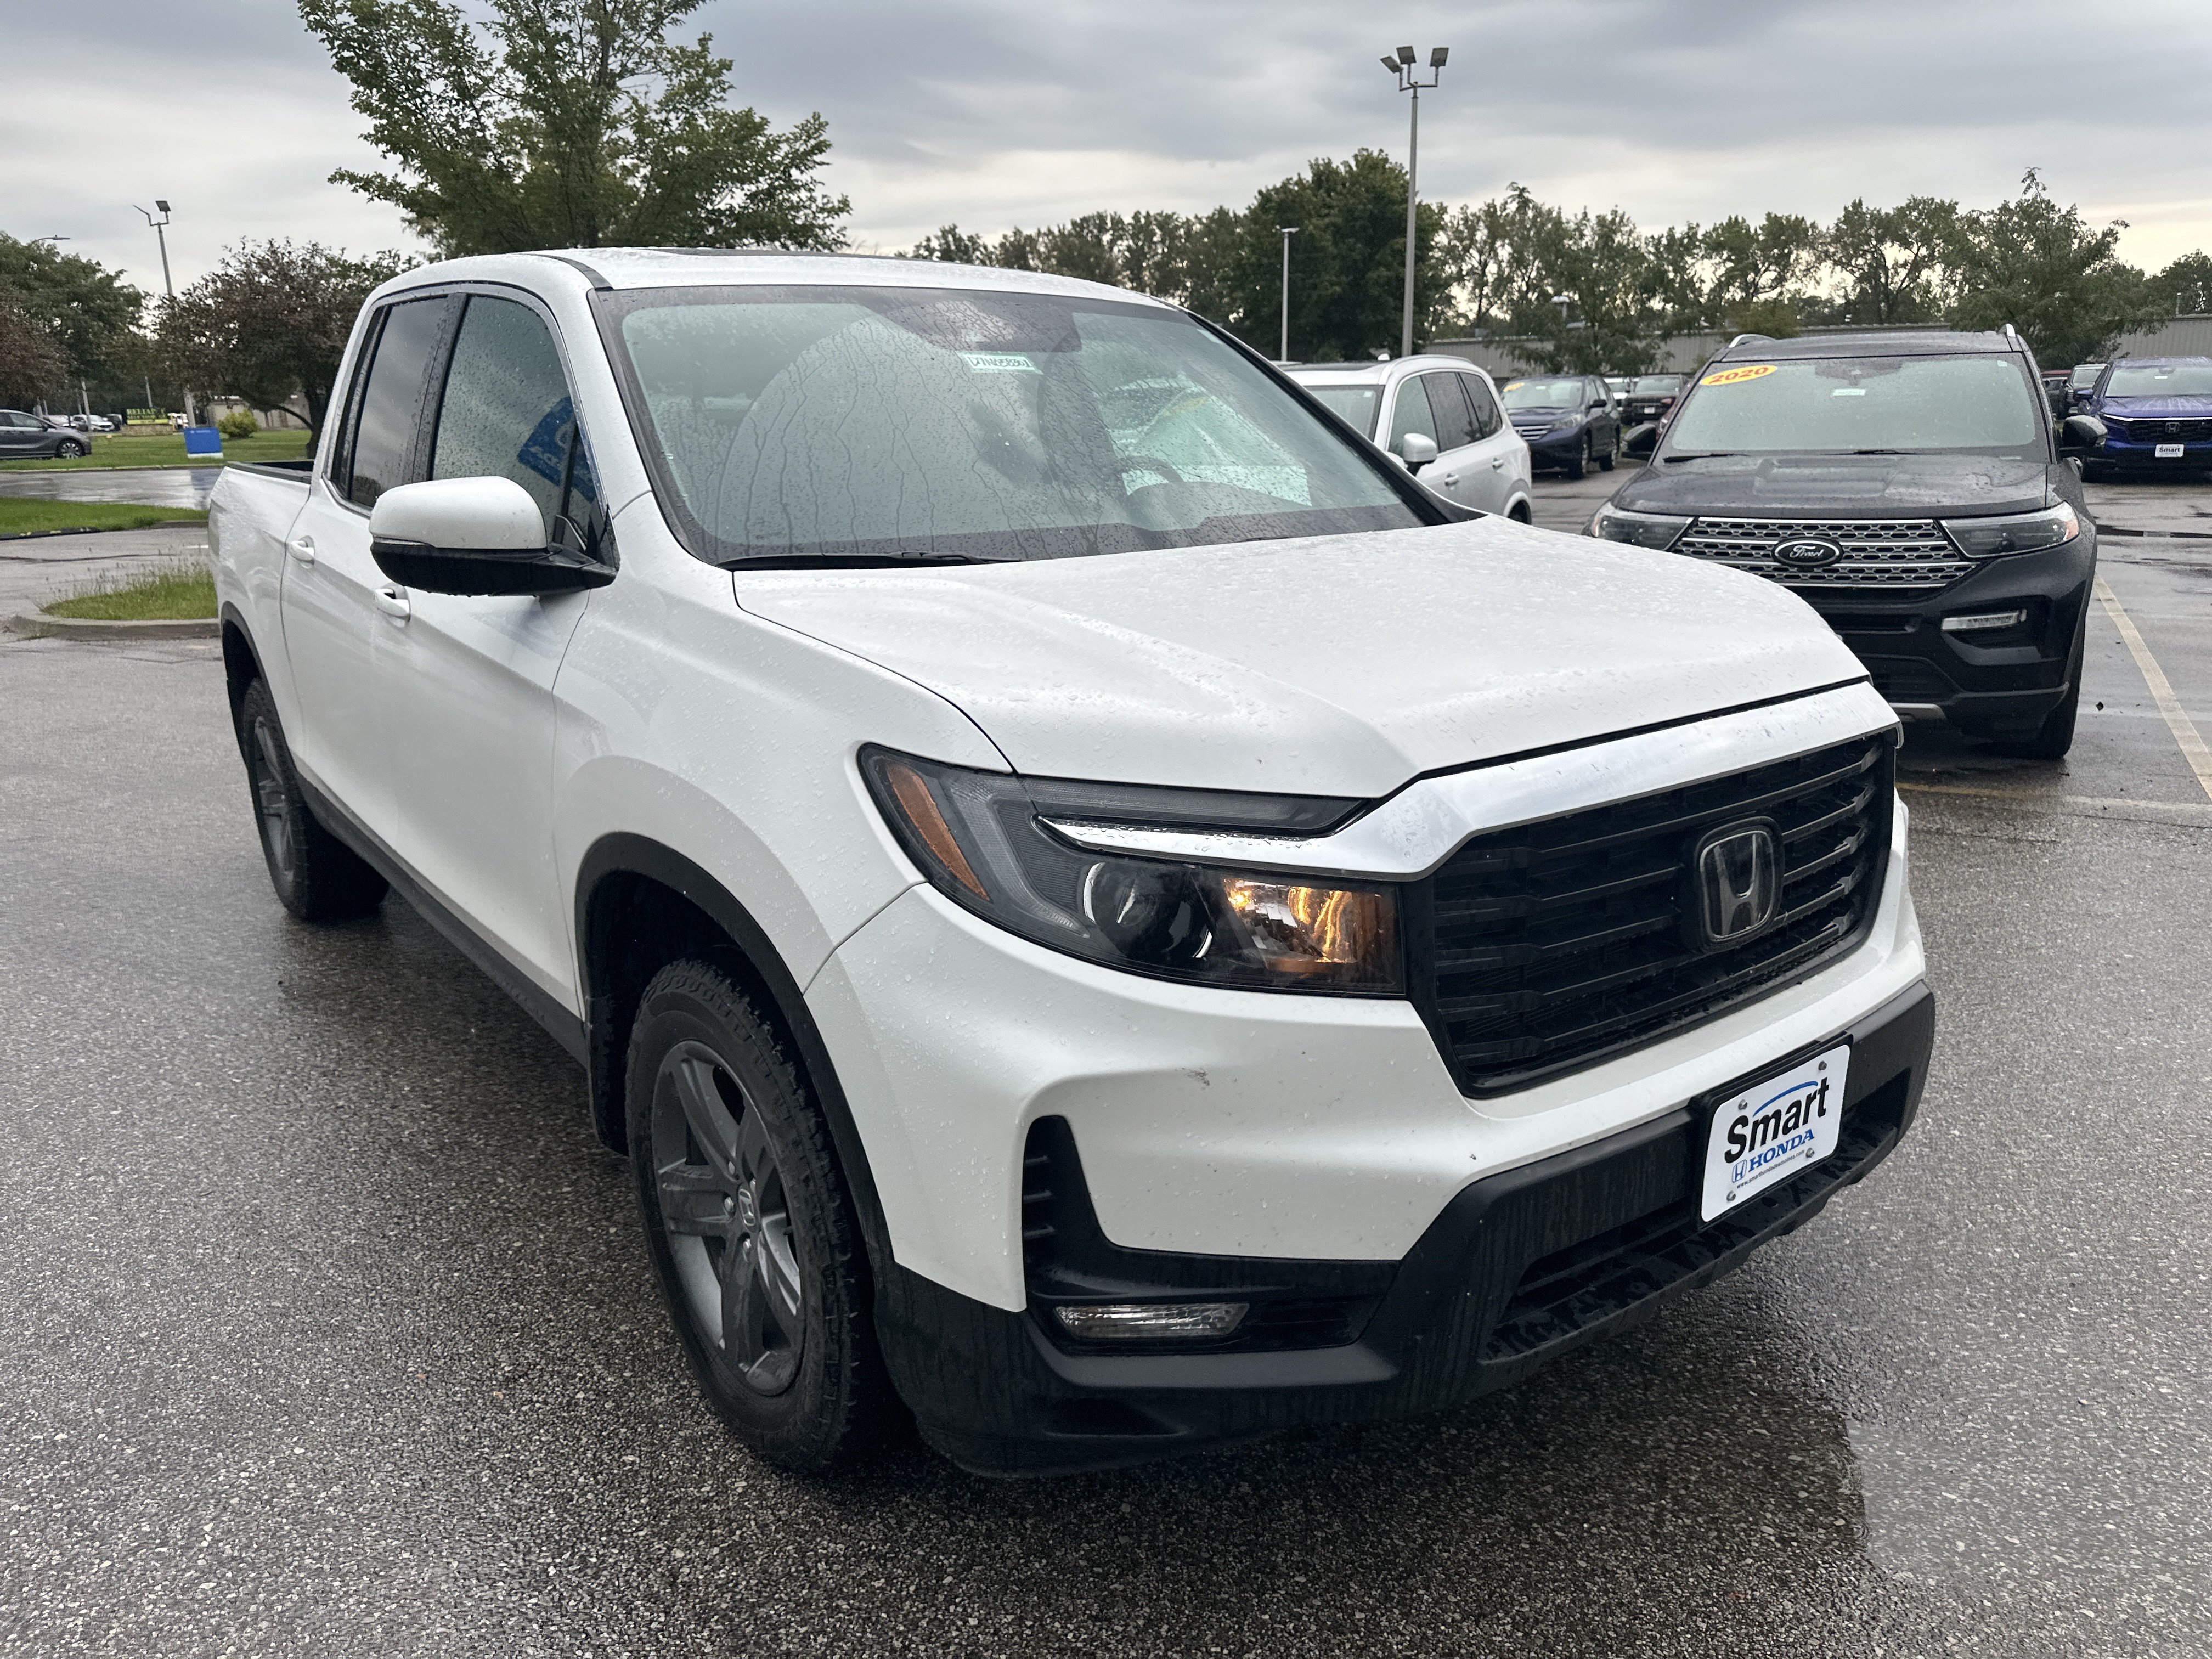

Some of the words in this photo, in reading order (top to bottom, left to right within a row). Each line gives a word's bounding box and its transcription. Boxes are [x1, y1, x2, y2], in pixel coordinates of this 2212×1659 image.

[1709, 367, 1768, 384] 2020
[1789, 545, 1824, 558] Ford
[1724, 1077, 1829, 1164] Smart
[1748, 1128, 1815, 1172] HONDA
